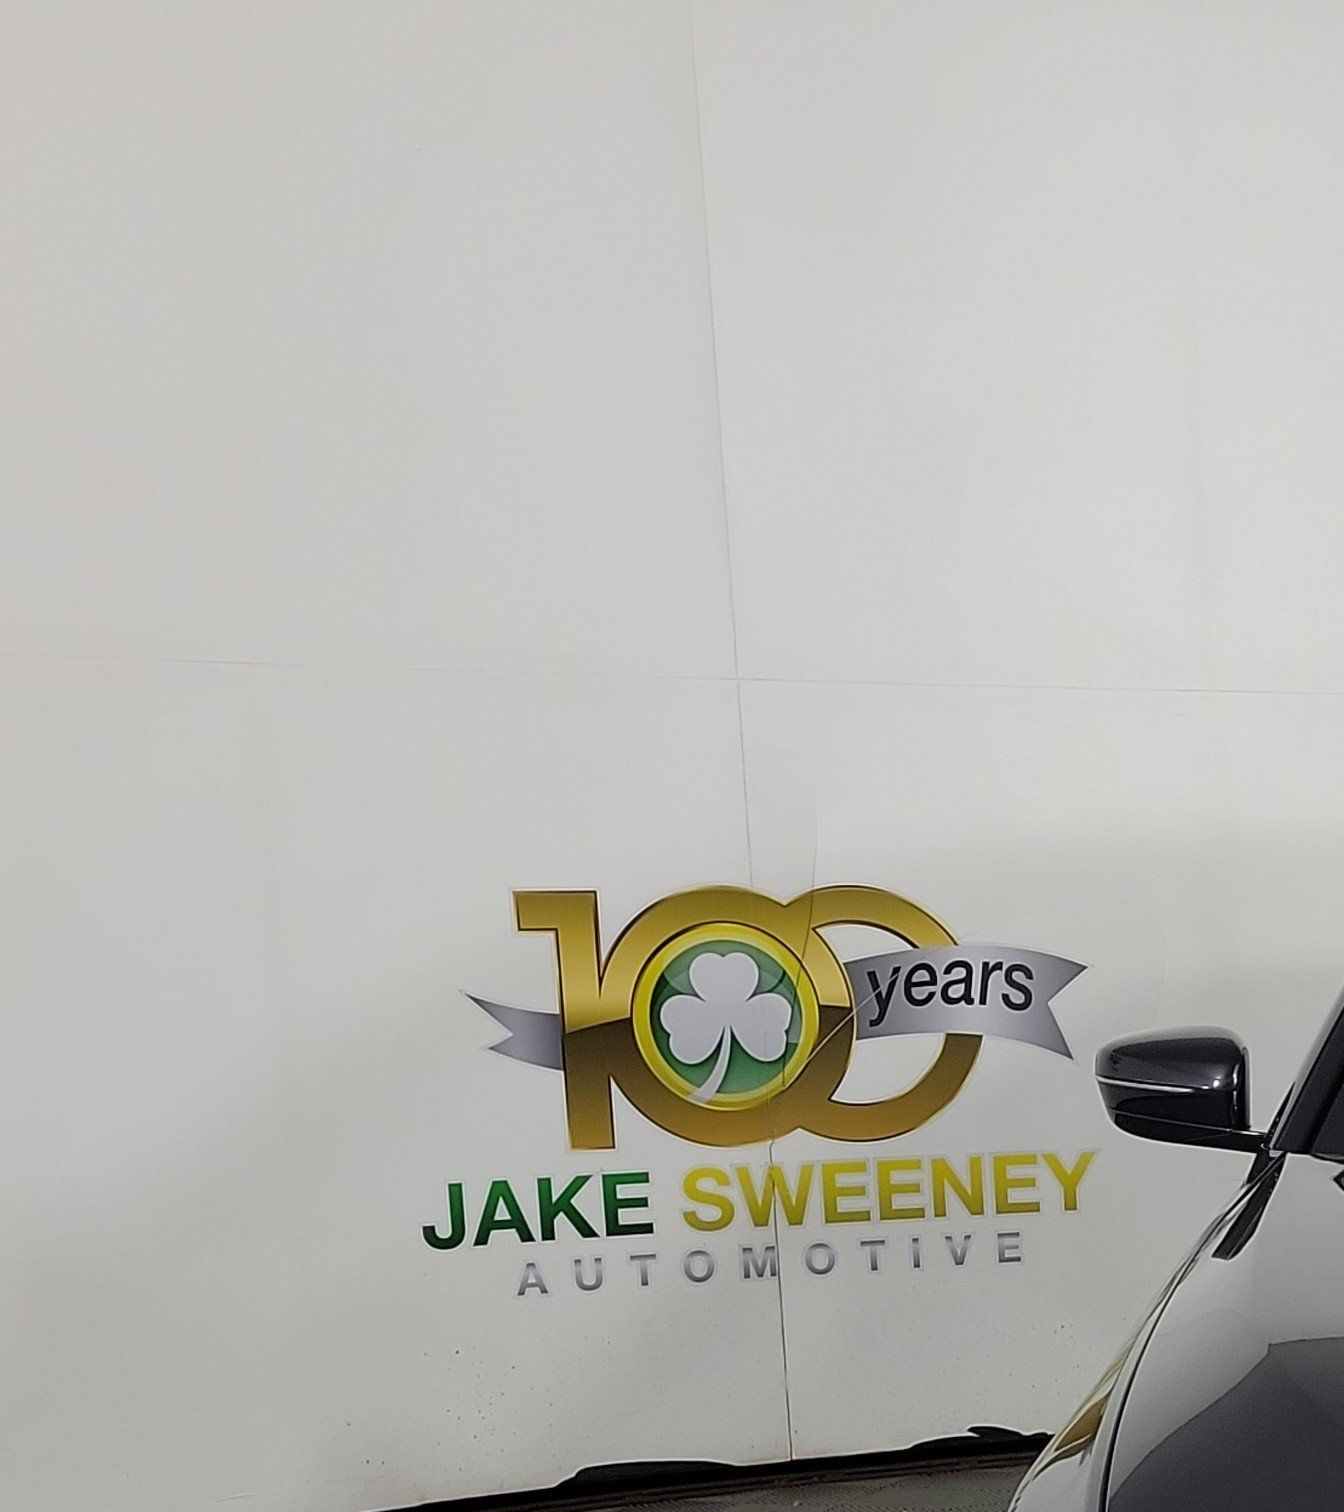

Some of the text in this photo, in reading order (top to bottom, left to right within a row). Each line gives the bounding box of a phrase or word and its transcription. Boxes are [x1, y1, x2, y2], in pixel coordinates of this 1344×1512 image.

[511, 885, 983, 1150] 100
[867, 959, 1034, 1028] years
[421, 1151, 1098, 1253] JAKE SWEENEY
[517, 1231, 1024, 1297] AUTOMOTIVE
